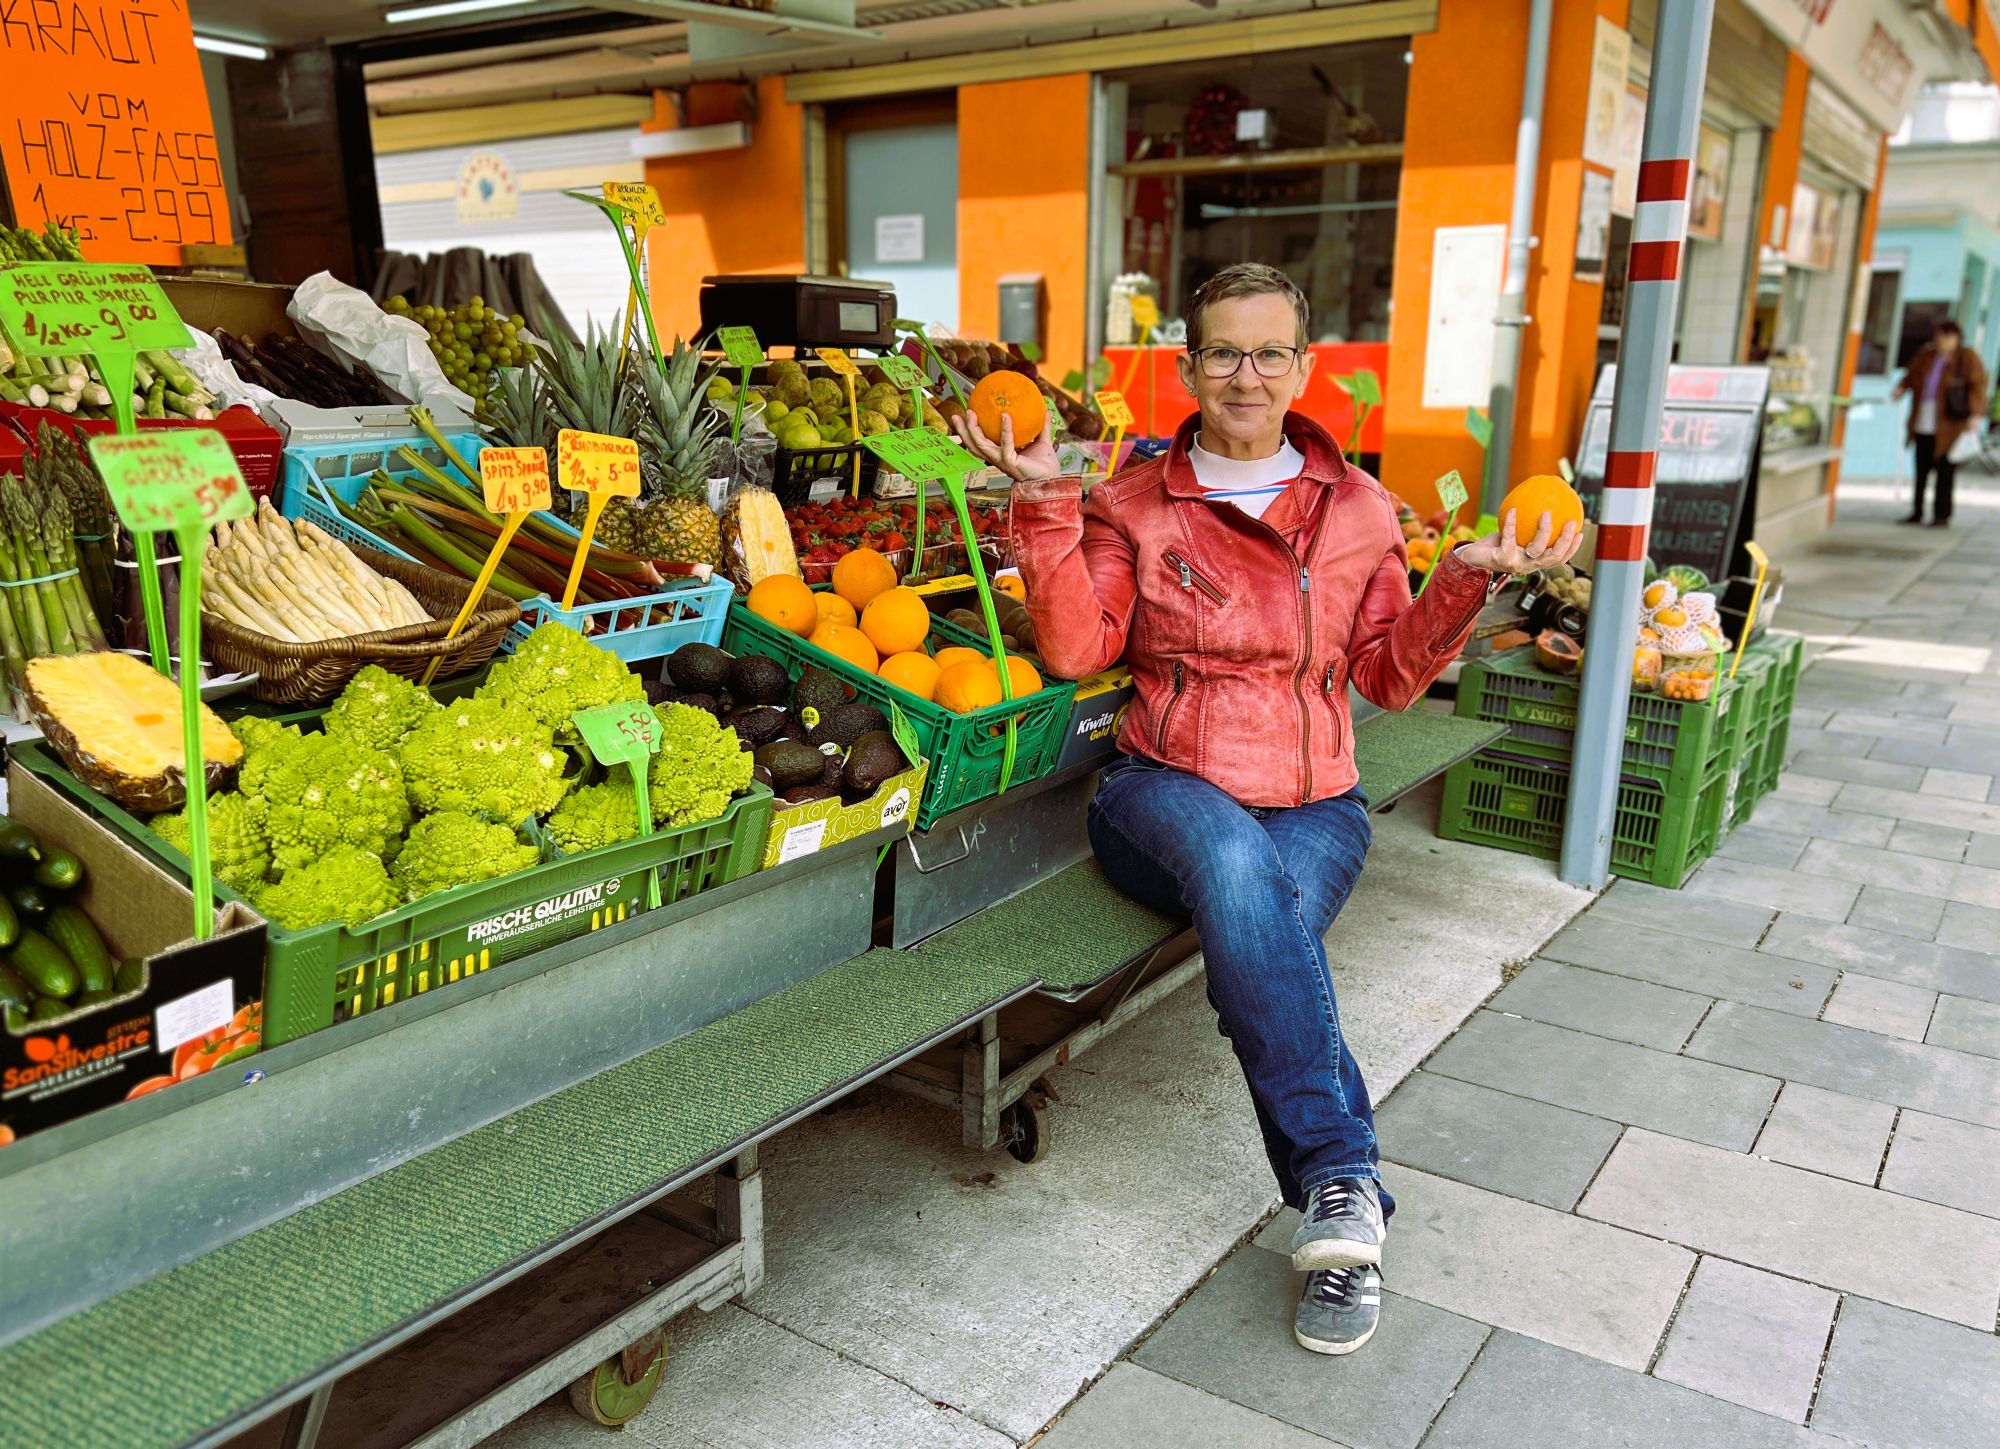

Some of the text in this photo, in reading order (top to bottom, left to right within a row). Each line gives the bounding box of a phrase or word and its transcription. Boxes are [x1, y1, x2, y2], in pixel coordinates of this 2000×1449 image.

[68, 91, 149, 123] VOM
[11, 273, 53, 288] HELL
[57, 270, 107, 287] GRÜN
[13, 288, 152, 306] PURPUR SPARGEL
[1076, 712, 1114, 735] Kiwita
[1089, 725, 1111, 741] Gold
[467, 905, 533, 942] FRISCHE
[482, 898, 606, 946] UNVERÄUSSERLICHE LEIHSTEIGE
[3, 1029, 150, 1090] SanSilvestre
